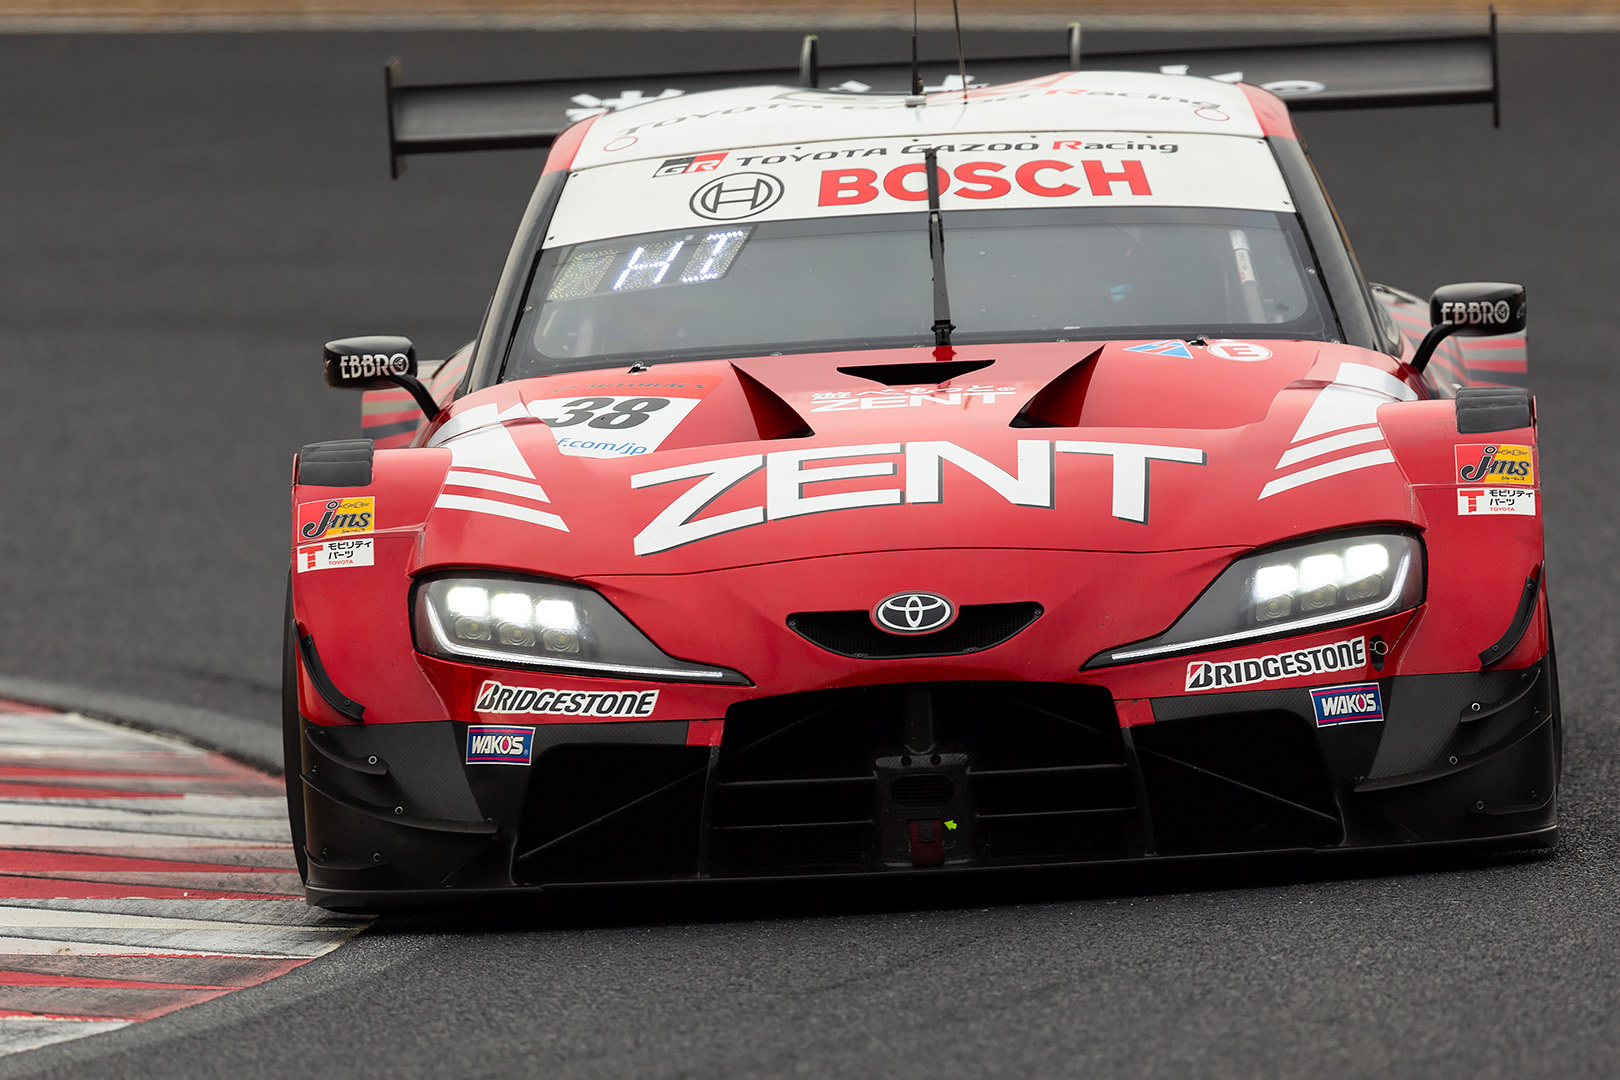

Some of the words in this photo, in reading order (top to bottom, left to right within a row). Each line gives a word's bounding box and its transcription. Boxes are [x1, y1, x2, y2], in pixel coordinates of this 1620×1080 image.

[653, 153, 728, 178] GR
[736, 148, 887, 167] TOYOTA
[1052, 140, 1179, 154] Racing
[817, 159, 1153, 208] BOSCH
[1441, 300, 1510, 325] EBBRO
[340, 353, 410, 379] EBBRO
[549, 397, 671, 430] 38
[810, 392, 1017, 413] ZENT
[556, 438, 648, 456] f.com/jp
[1460, 445, 1531, 482] jms
[630, 439, 1208, 557] ZENT
[1488, 489, 1533, 498] モビリティ
[1489, 498, 1515, 506] パーツ
[301, 500, 372, 539] jms
[328, 540, 372, 550] モビリティ
[328, 550, 354, 560] パーツ
[1188, 638, 1365, 689] BRIDGESTONE
[476, 682, 656, 715] BRIDGESTONE
